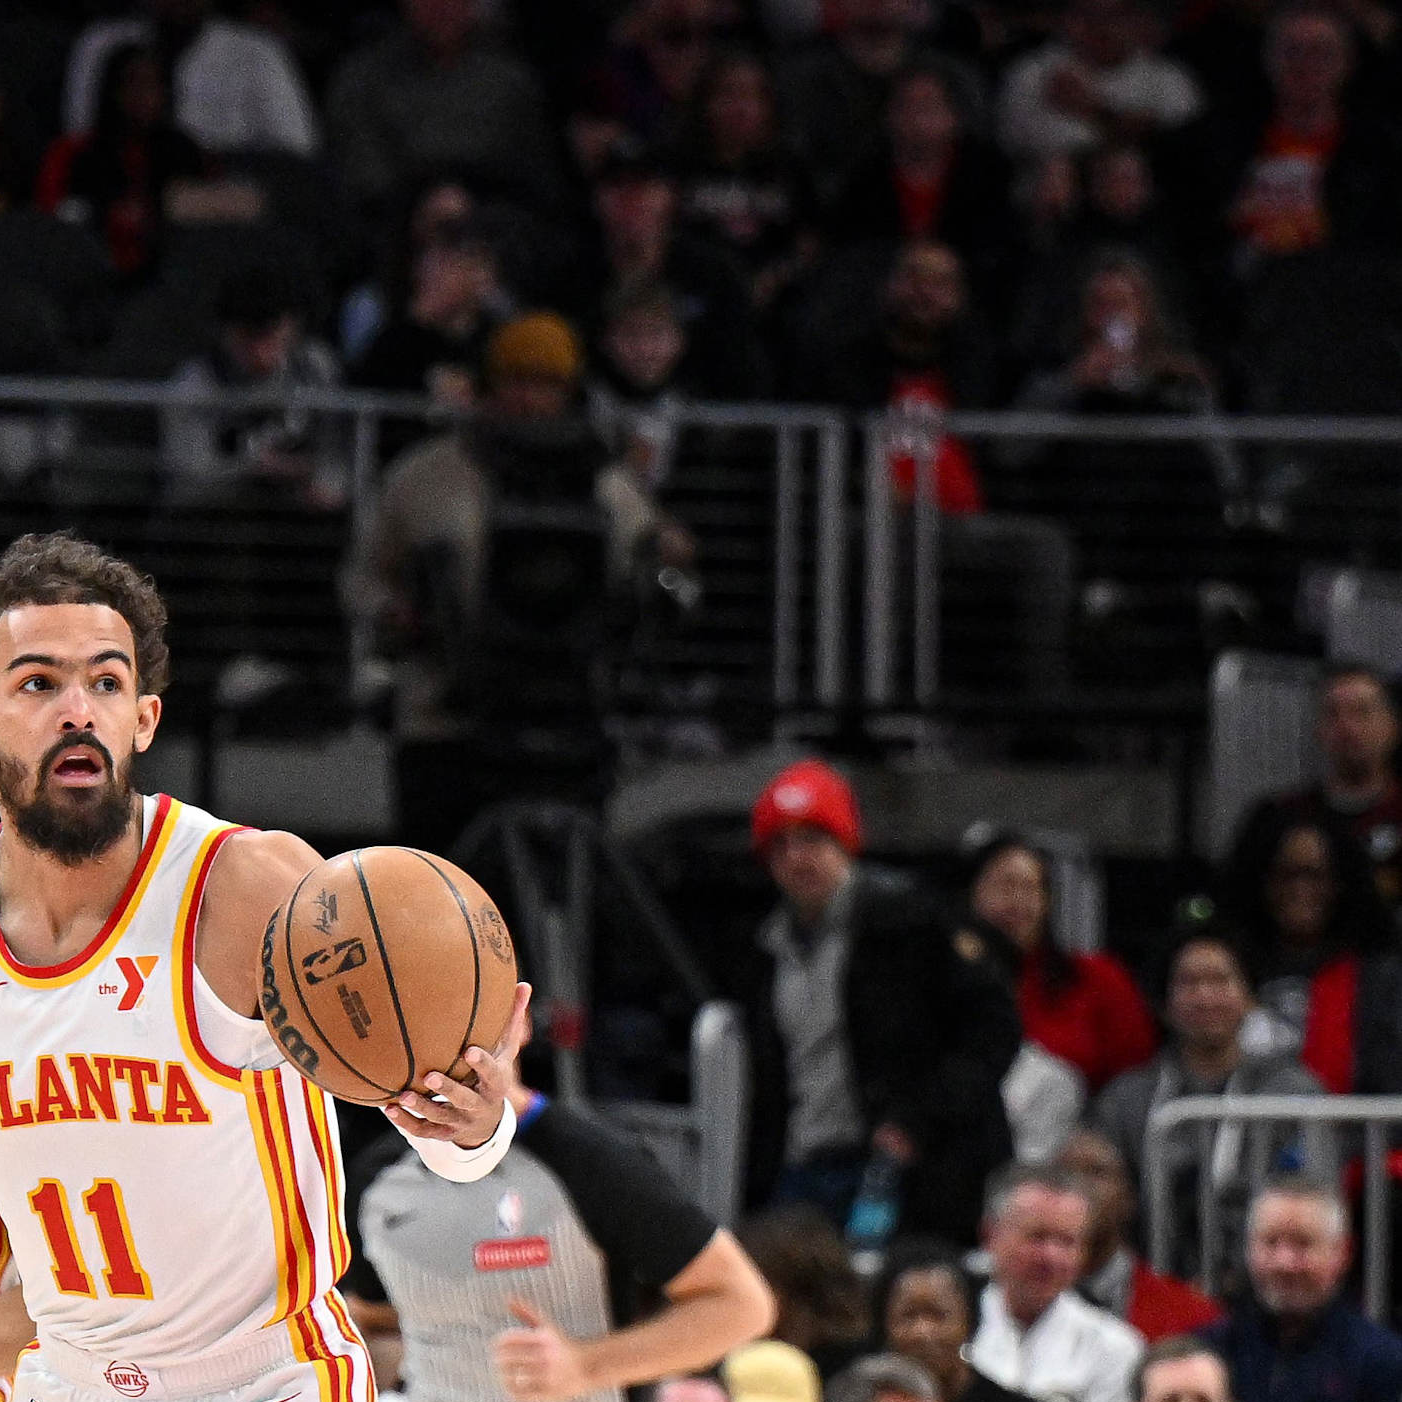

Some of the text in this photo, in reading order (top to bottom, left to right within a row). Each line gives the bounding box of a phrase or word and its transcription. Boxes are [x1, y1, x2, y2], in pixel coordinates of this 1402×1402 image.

[98, 983, 118, 995] the
[27, 1178, 154, 1300] 11
[103, 1371, 150, 1388] HAWKS
